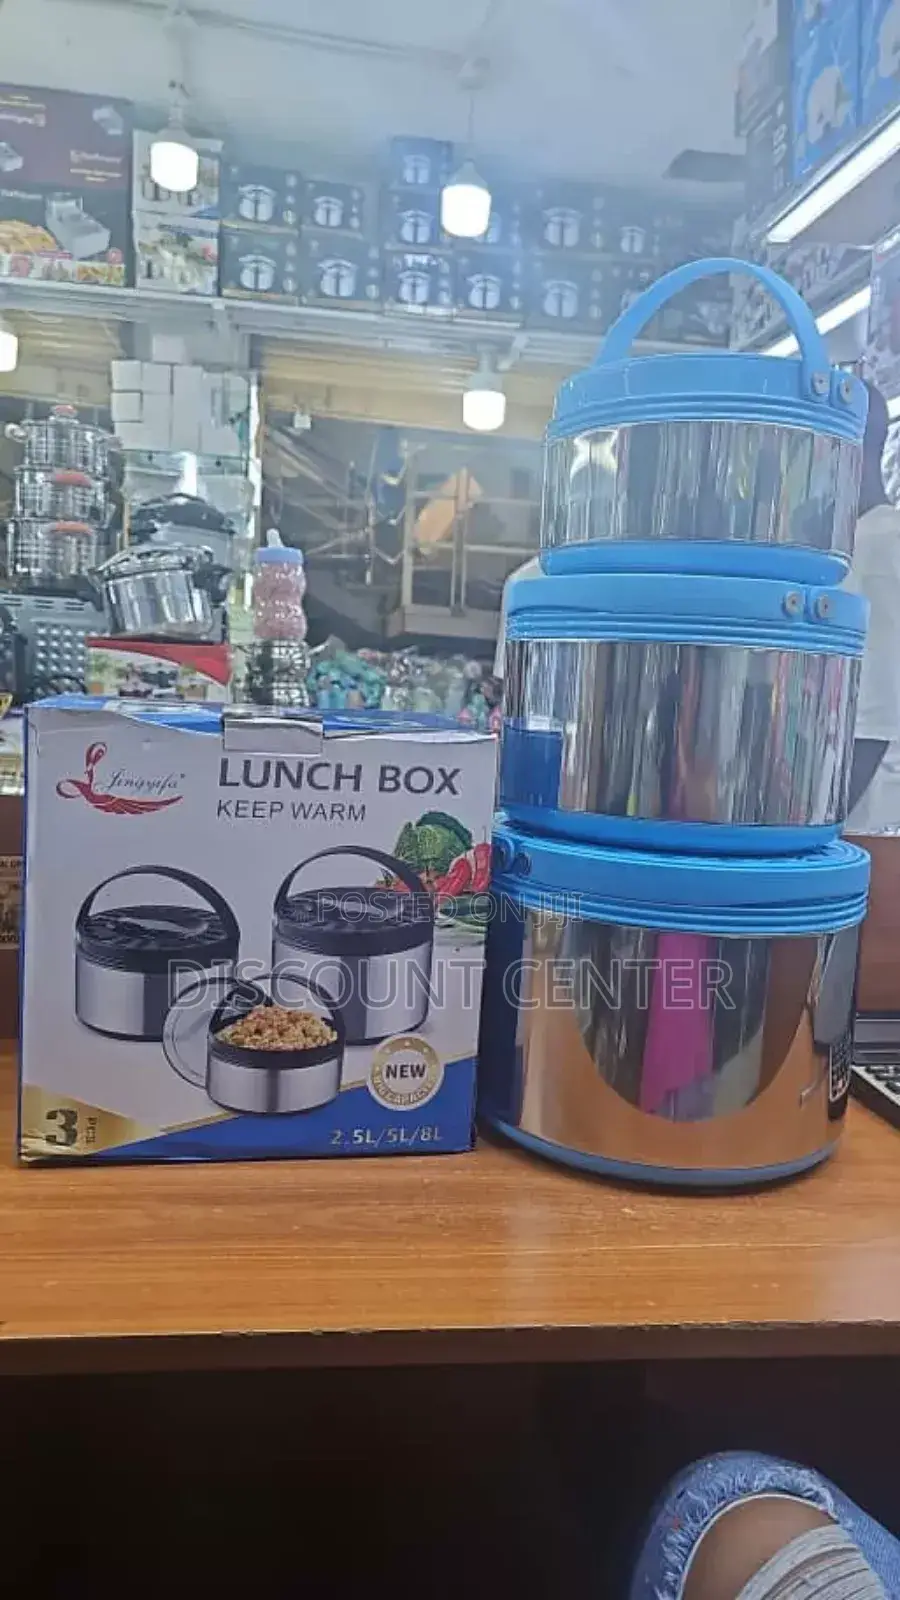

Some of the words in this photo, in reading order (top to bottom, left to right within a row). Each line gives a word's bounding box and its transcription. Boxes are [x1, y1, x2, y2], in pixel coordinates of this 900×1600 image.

[219, 758, 363, 792] LUNCH
[378, 765, 461, 796] BOX
[216, 799, 284, 820] KEEP
[291, 802, 366, 822] WARM
[385, 1063, 426, 1079] NEW
[45, 1108, 78, 1146] 3
